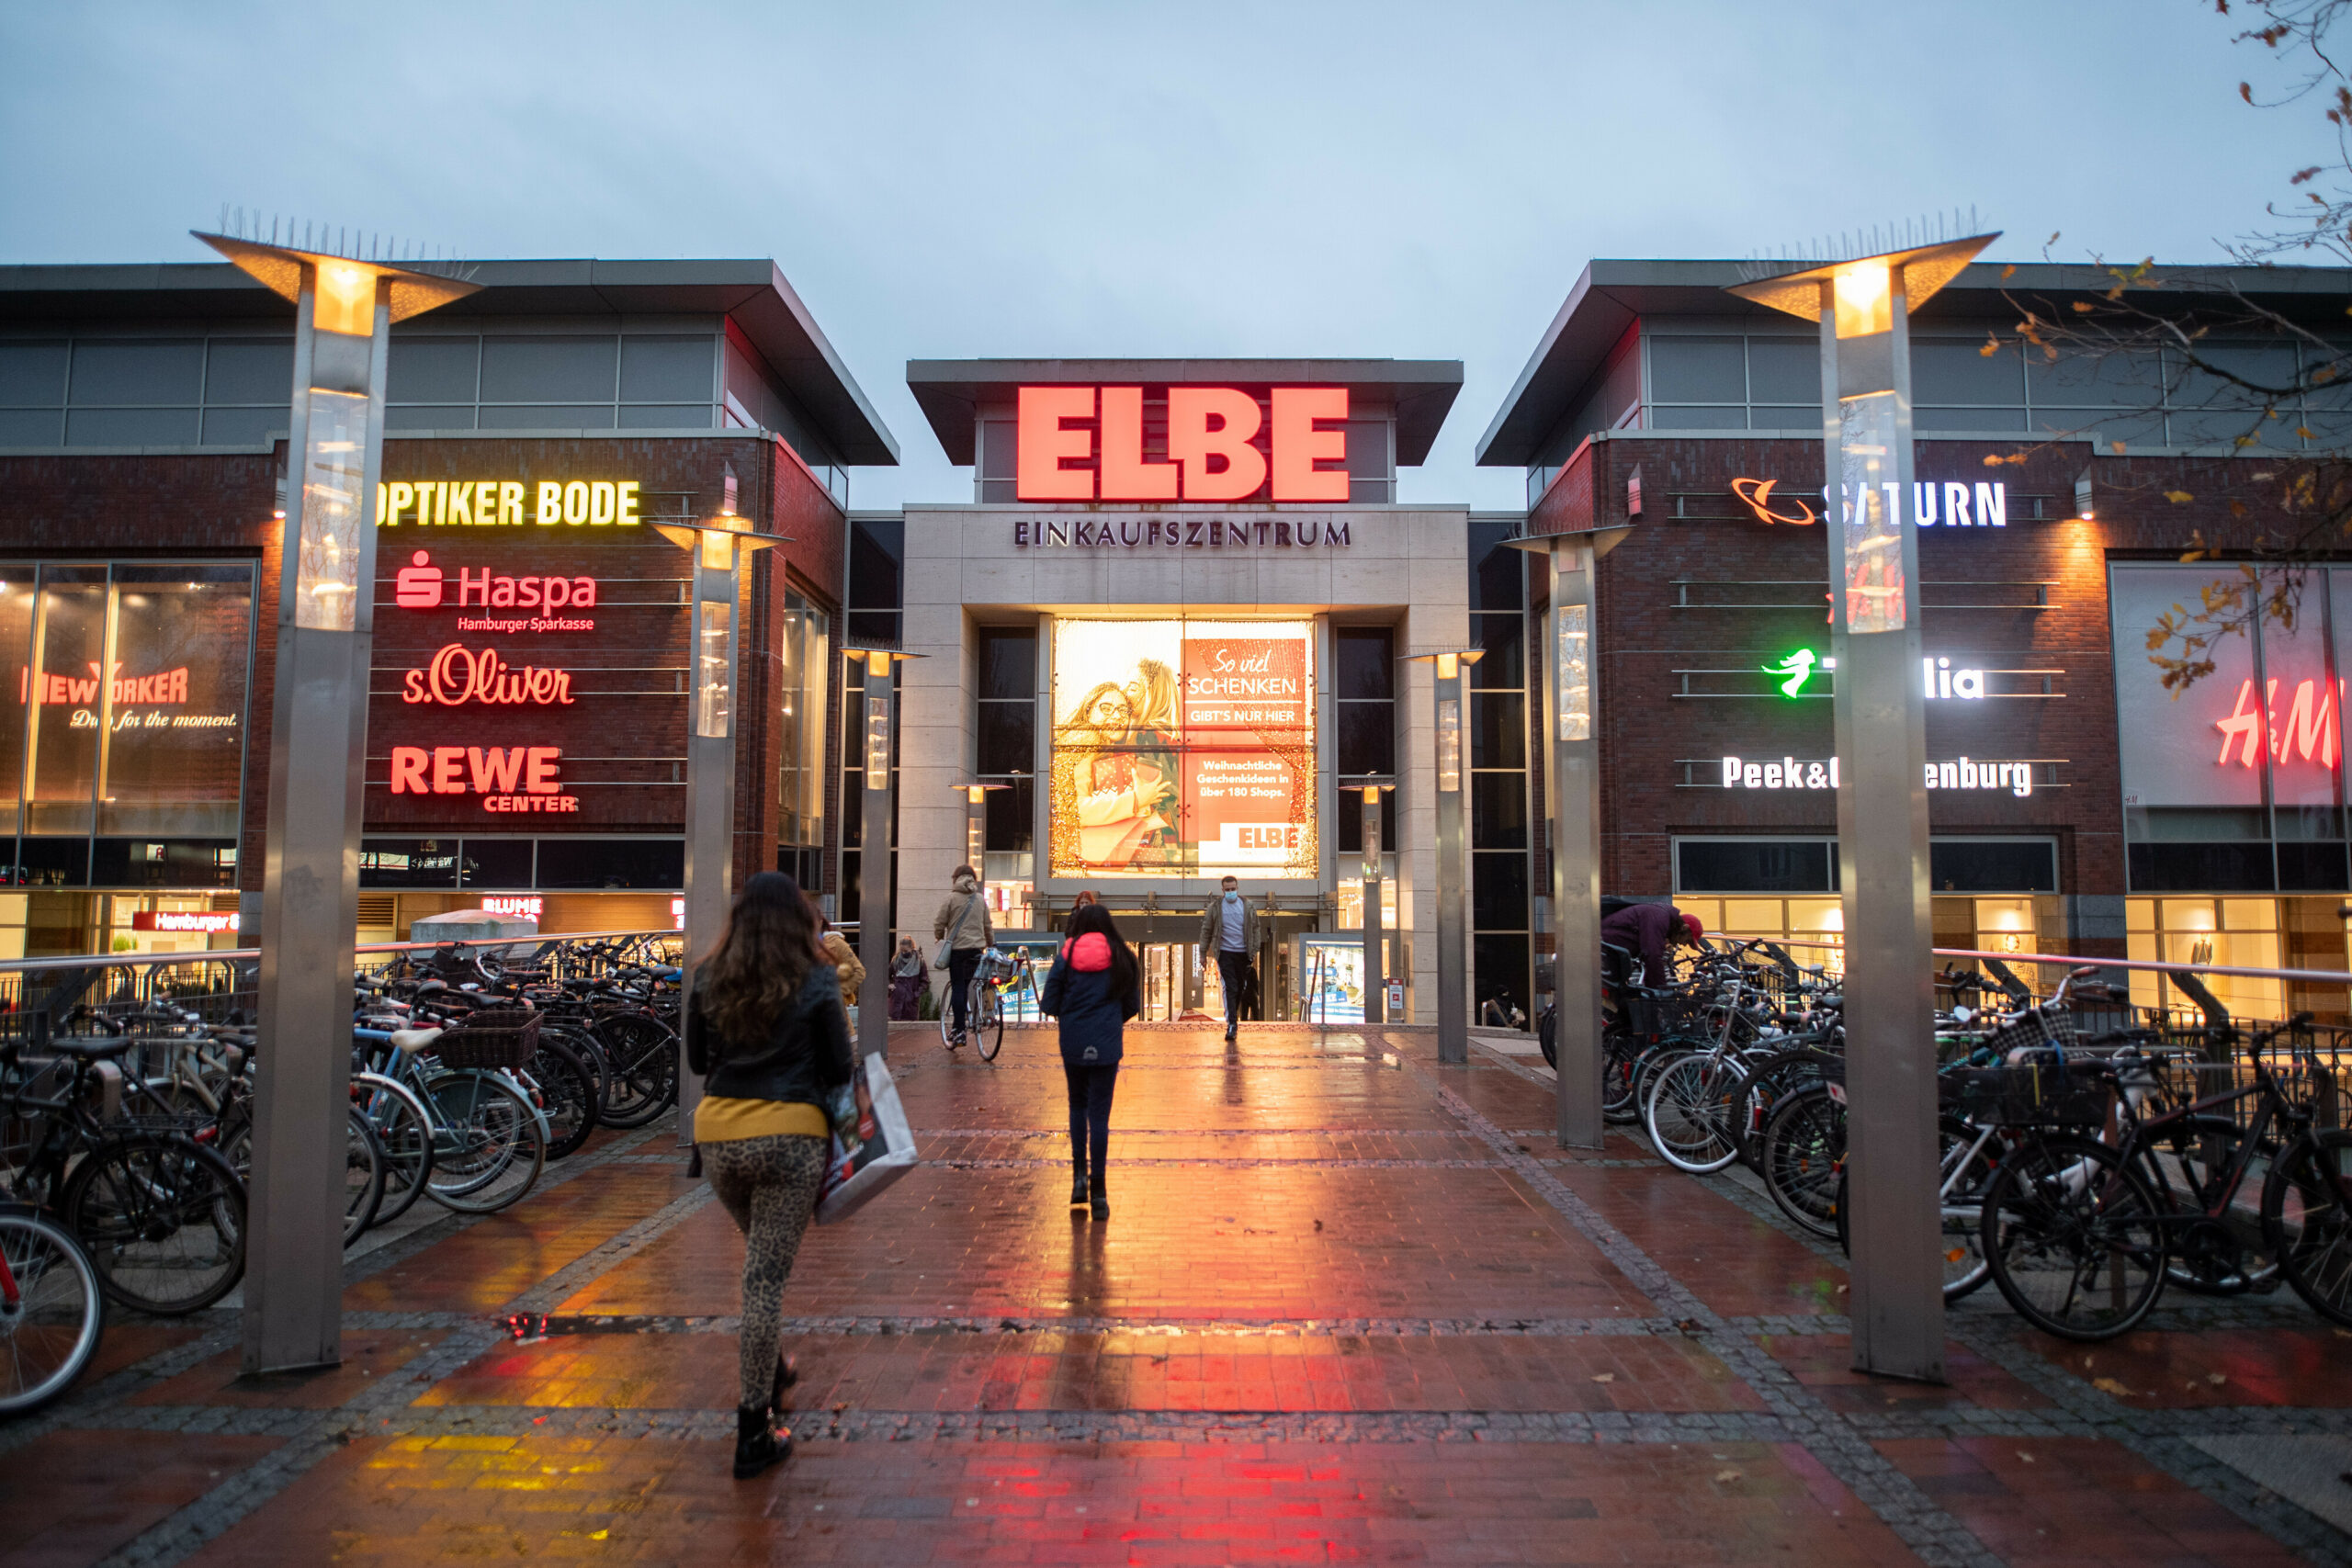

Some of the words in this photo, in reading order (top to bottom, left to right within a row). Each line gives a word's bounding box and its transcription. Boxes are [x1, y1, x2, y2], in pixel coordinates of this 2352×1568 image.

[1017, 386, 1350, 502] ELBE
[537, 480, 640, 526] BODE
[1014, 521, 1351, 547] EINKAUFSZENTRUM
[458, 567, 597, 616] Haspa
[458, 616, 529, 633] Hamburger
[530, 617, 594, 633] Sparkasse
[1213, 649, 1236, 672] So
[1240, 649, 1272, 672] viel
[402, 643, 575, 705] s.Oliver
[1188, 678, 1296, 694] SCHENKEN
[145, 710, 168, 727] the
[173, 713, 237, 727] moment.
[1191, 710, 1230, 721] GIBT'S
[1235, 710, 1262, 721] NUR
[1266, 710, 1295, 721] HIER
[390, 746, 562, 795] REWE
[1204, 761, 1283, 771] Weihnachtliche
[1197, 773, 1276, 784] Geschenkideen
[1279, 773, 1289, 784] in
[1200, 787, 1224, 797] über
[1227, 787, 1248, 797] 180
[1250, 787, 1285, 799] Shops.
[483, 795, 579, 812] CENTER
[1238, 828, 1298, 849] ELBE
[483, 897, 543, 915] BLUME
[155, 913, 229, 931] Hamburger
